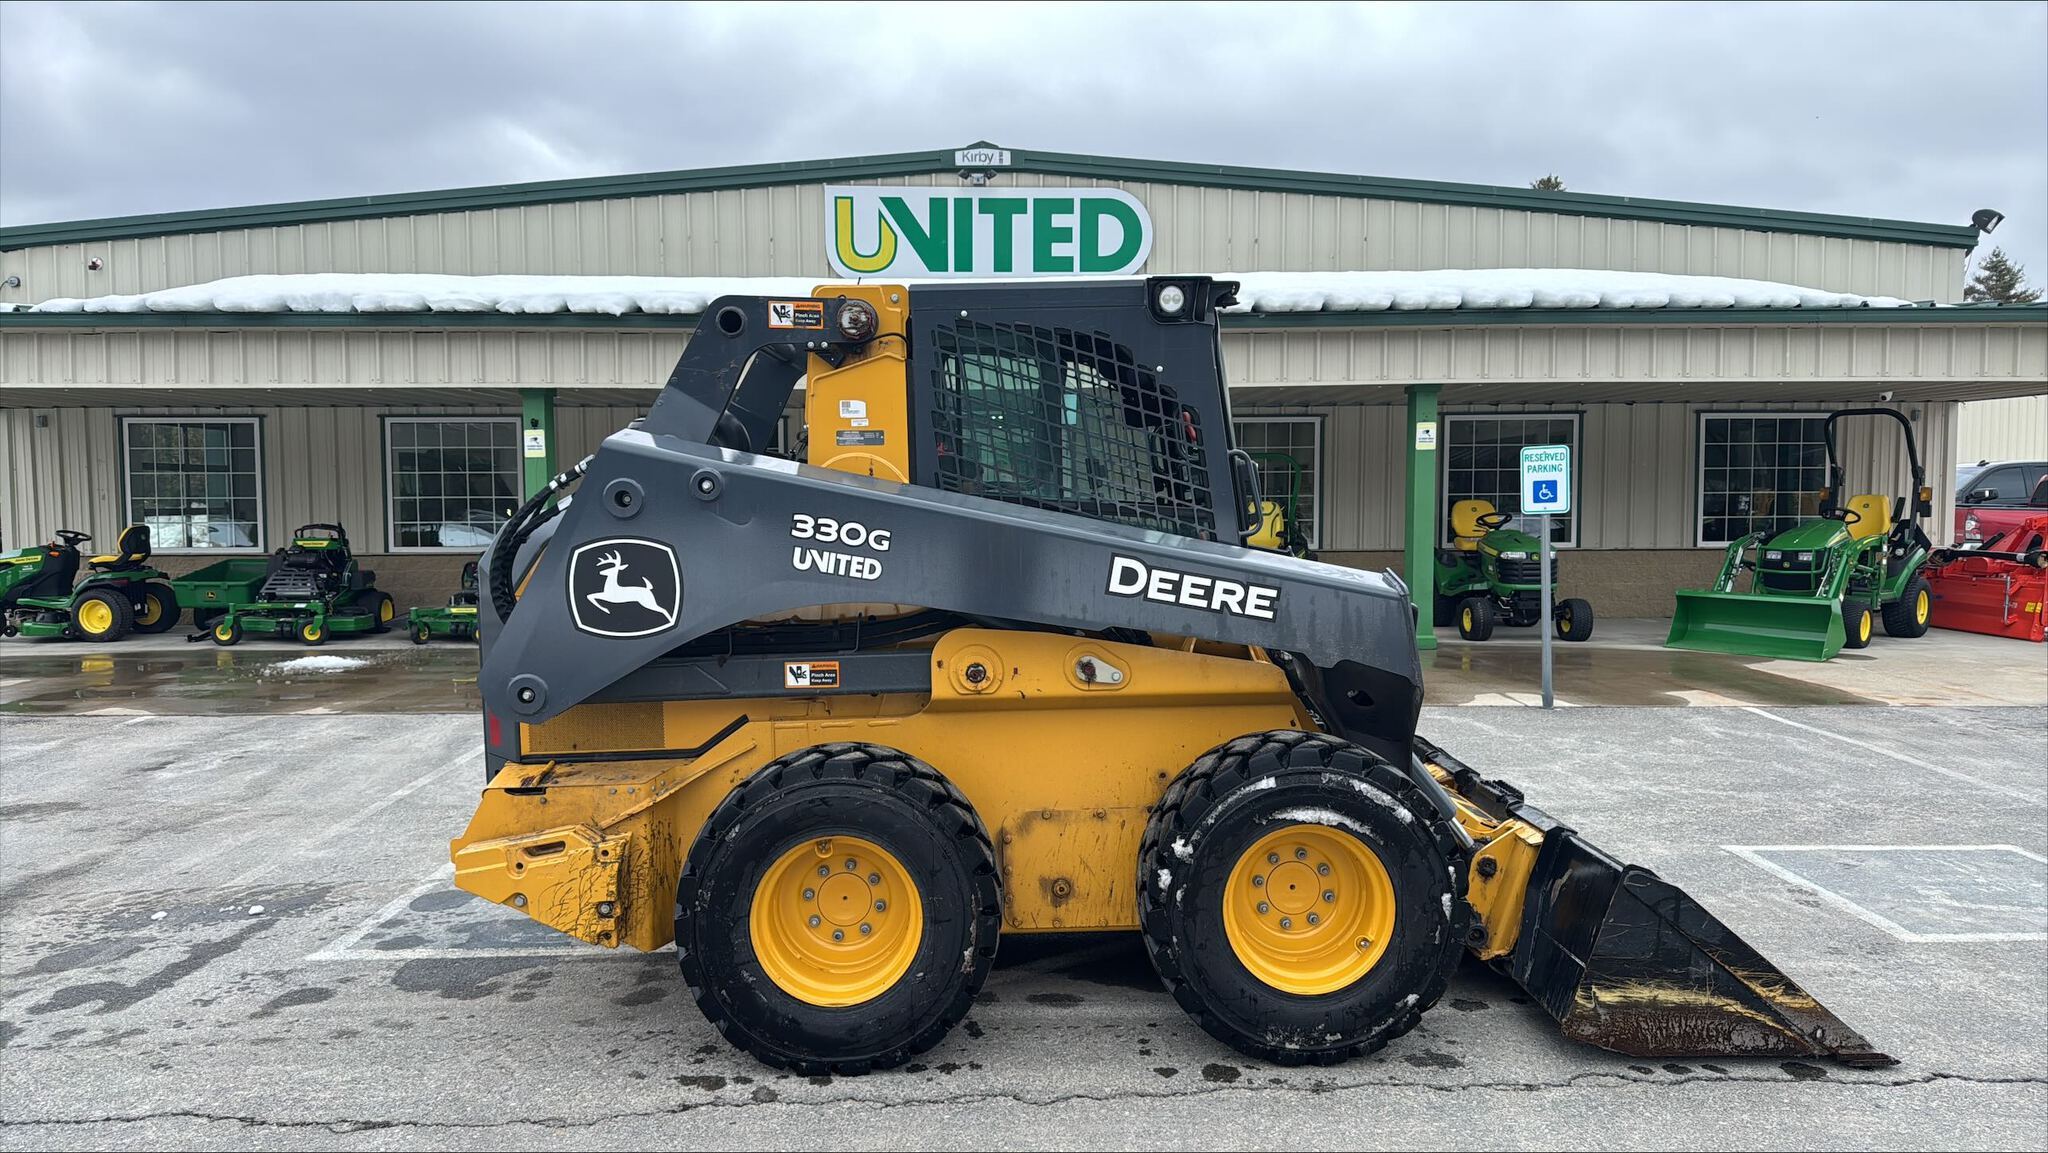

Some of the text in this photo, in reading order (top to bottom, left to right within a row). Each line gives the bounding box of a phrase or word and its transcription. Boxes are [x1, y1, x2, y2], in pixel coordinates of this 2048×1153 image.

[962, 151, 994, 164] Kirby
[834, 196, 1143, 273] UNITED
[1524, 452, 1566, 463] RESERVED
[1527, 463, 1563, 473] PARKING
[791, 514, 891, 551] 330G
[792, 546, 883, 580] UNITED
[1108, 556, 1278, 619] DEERE
